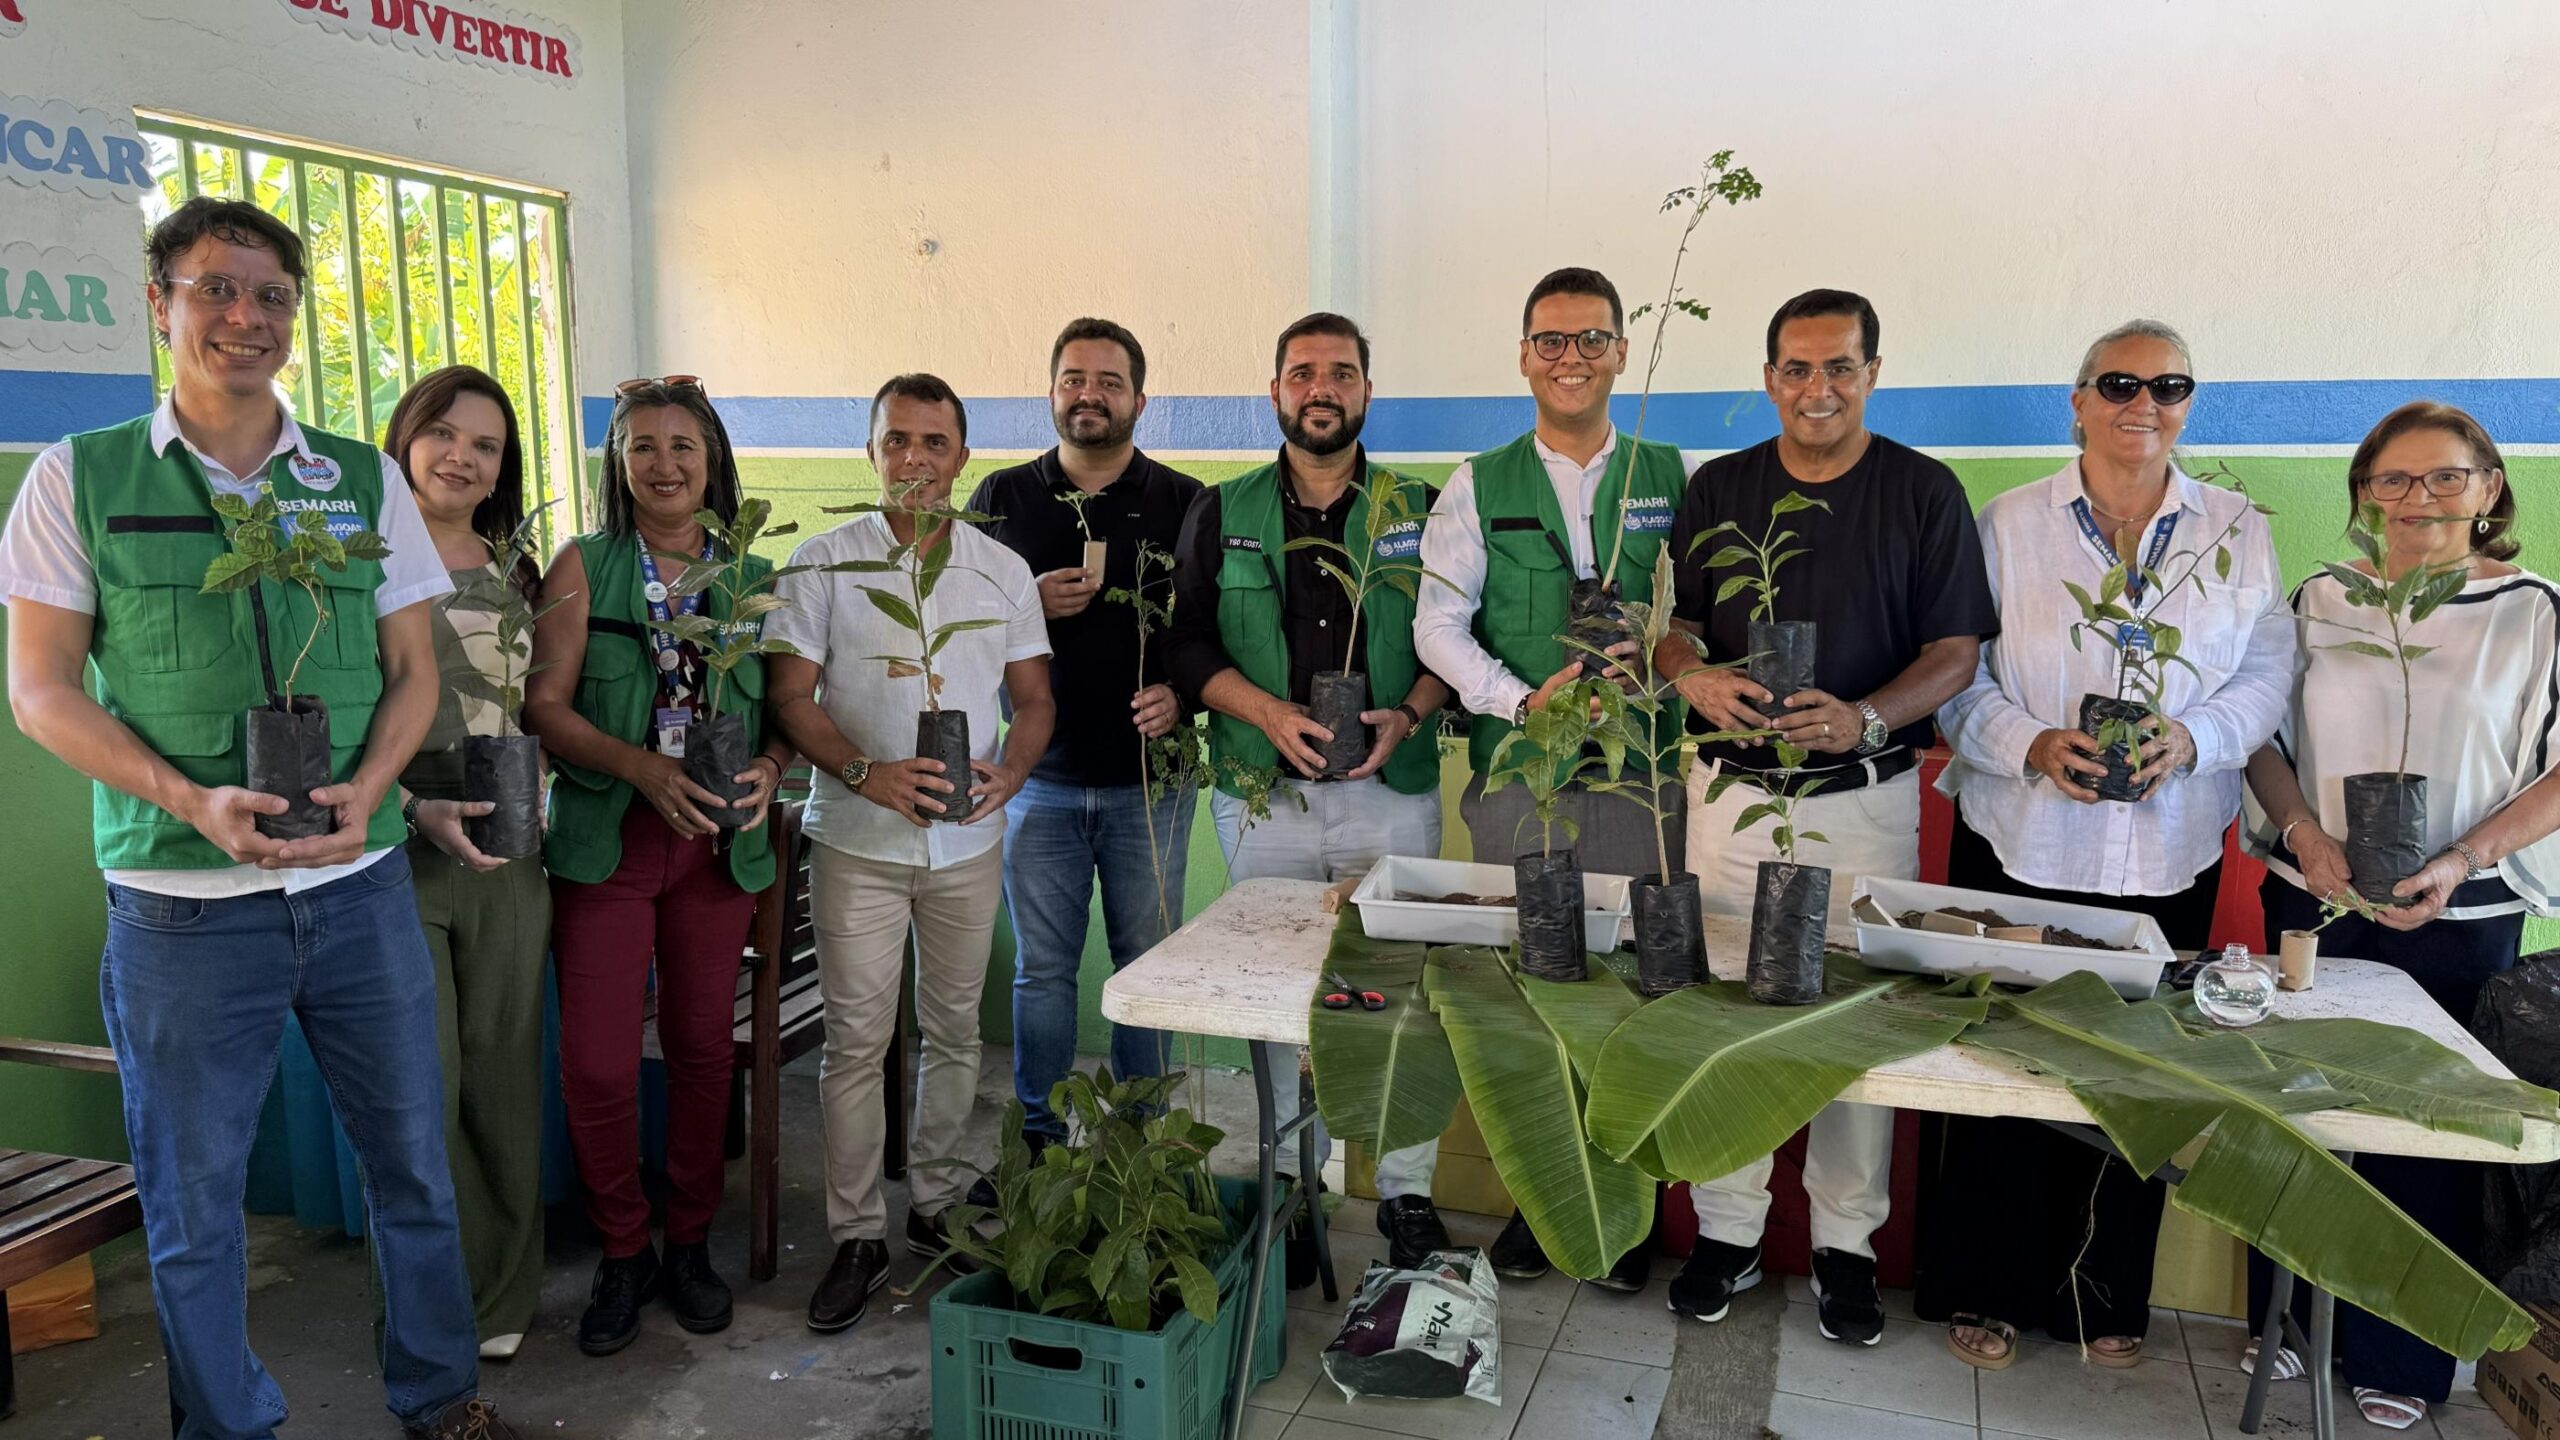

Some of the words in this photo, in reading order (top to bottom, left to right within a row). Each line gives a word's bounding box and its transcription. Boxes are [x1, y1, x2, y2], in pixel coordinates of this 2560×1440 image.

[371, 0, 573, 78] DIVERTIR
[278, 499, 357, 513] SEMARH
[1618, 496, 1669, 510] SEMARH
[1381, 520, 1420, 536] MARH
[2091, 534, 2118, 566] SEMAR
[654, 606, 670, 647] SERH
